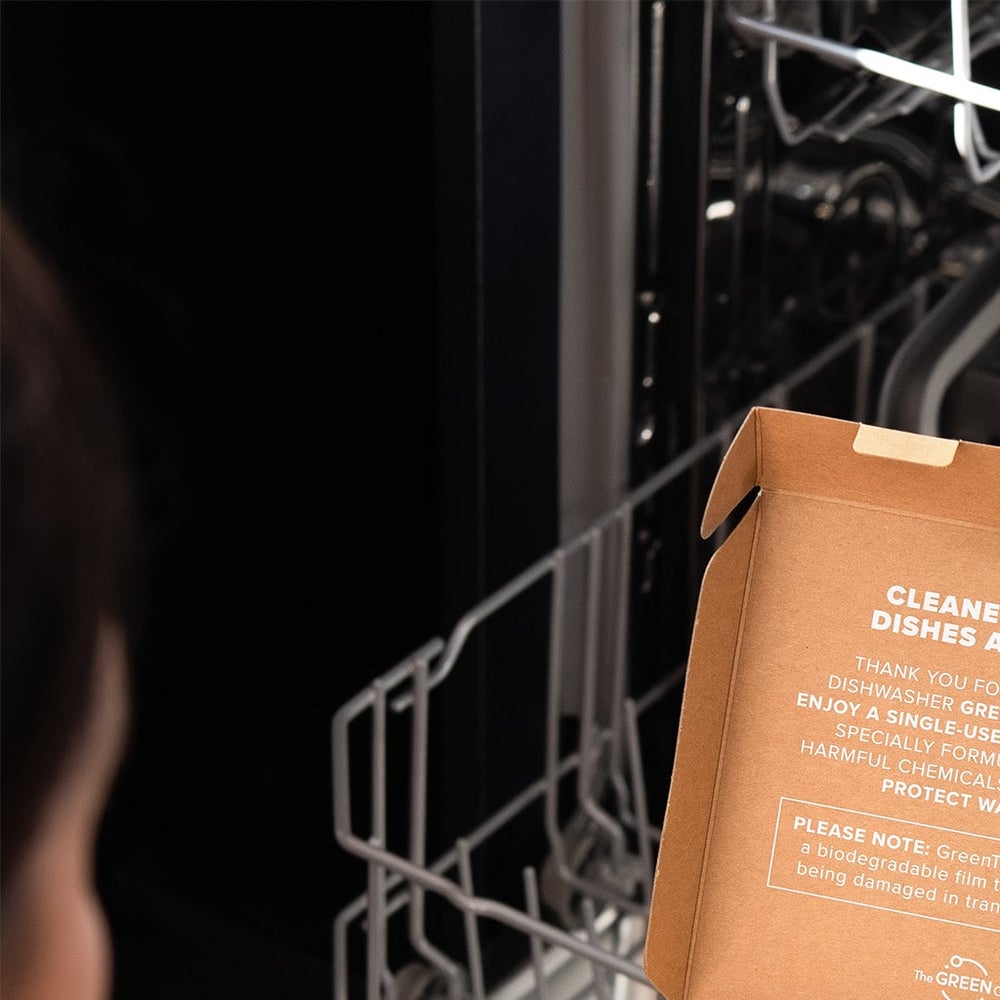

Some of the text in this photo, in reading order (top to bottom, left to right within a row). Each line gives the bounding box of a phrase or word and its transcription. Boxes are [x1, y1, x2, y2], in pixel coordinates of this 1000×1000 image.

[870, 609, 977, 647] DISHES
[855, 655, 920, 682] THANK
[927, 669, 968, 690] YOU
[796, 691, 861, 717] ENJOY
[865, 706, 880, 721] A
[828, 674, 954, 712] DISHWASHER
[800, 739, 891, 770] HARMFUL
[835, 722, 935, 754] SPECIALLY
[881, 778, 973, 808] PROTECT
[793, 815, 867, 843] PLEASE
[871, 831, 930, 856] NOTE:
[796, 860, 847, 887] being
[853, 873, 937, 901] damaged
[943, 893, 959, 906] in
[800, 842, 811, 854] a
[817, 842, 949, 882] biodegradable
[955, 870, 987, 889] film
[913, 969, 934, 984] The
[935, 971, 993, 995] GREEN
